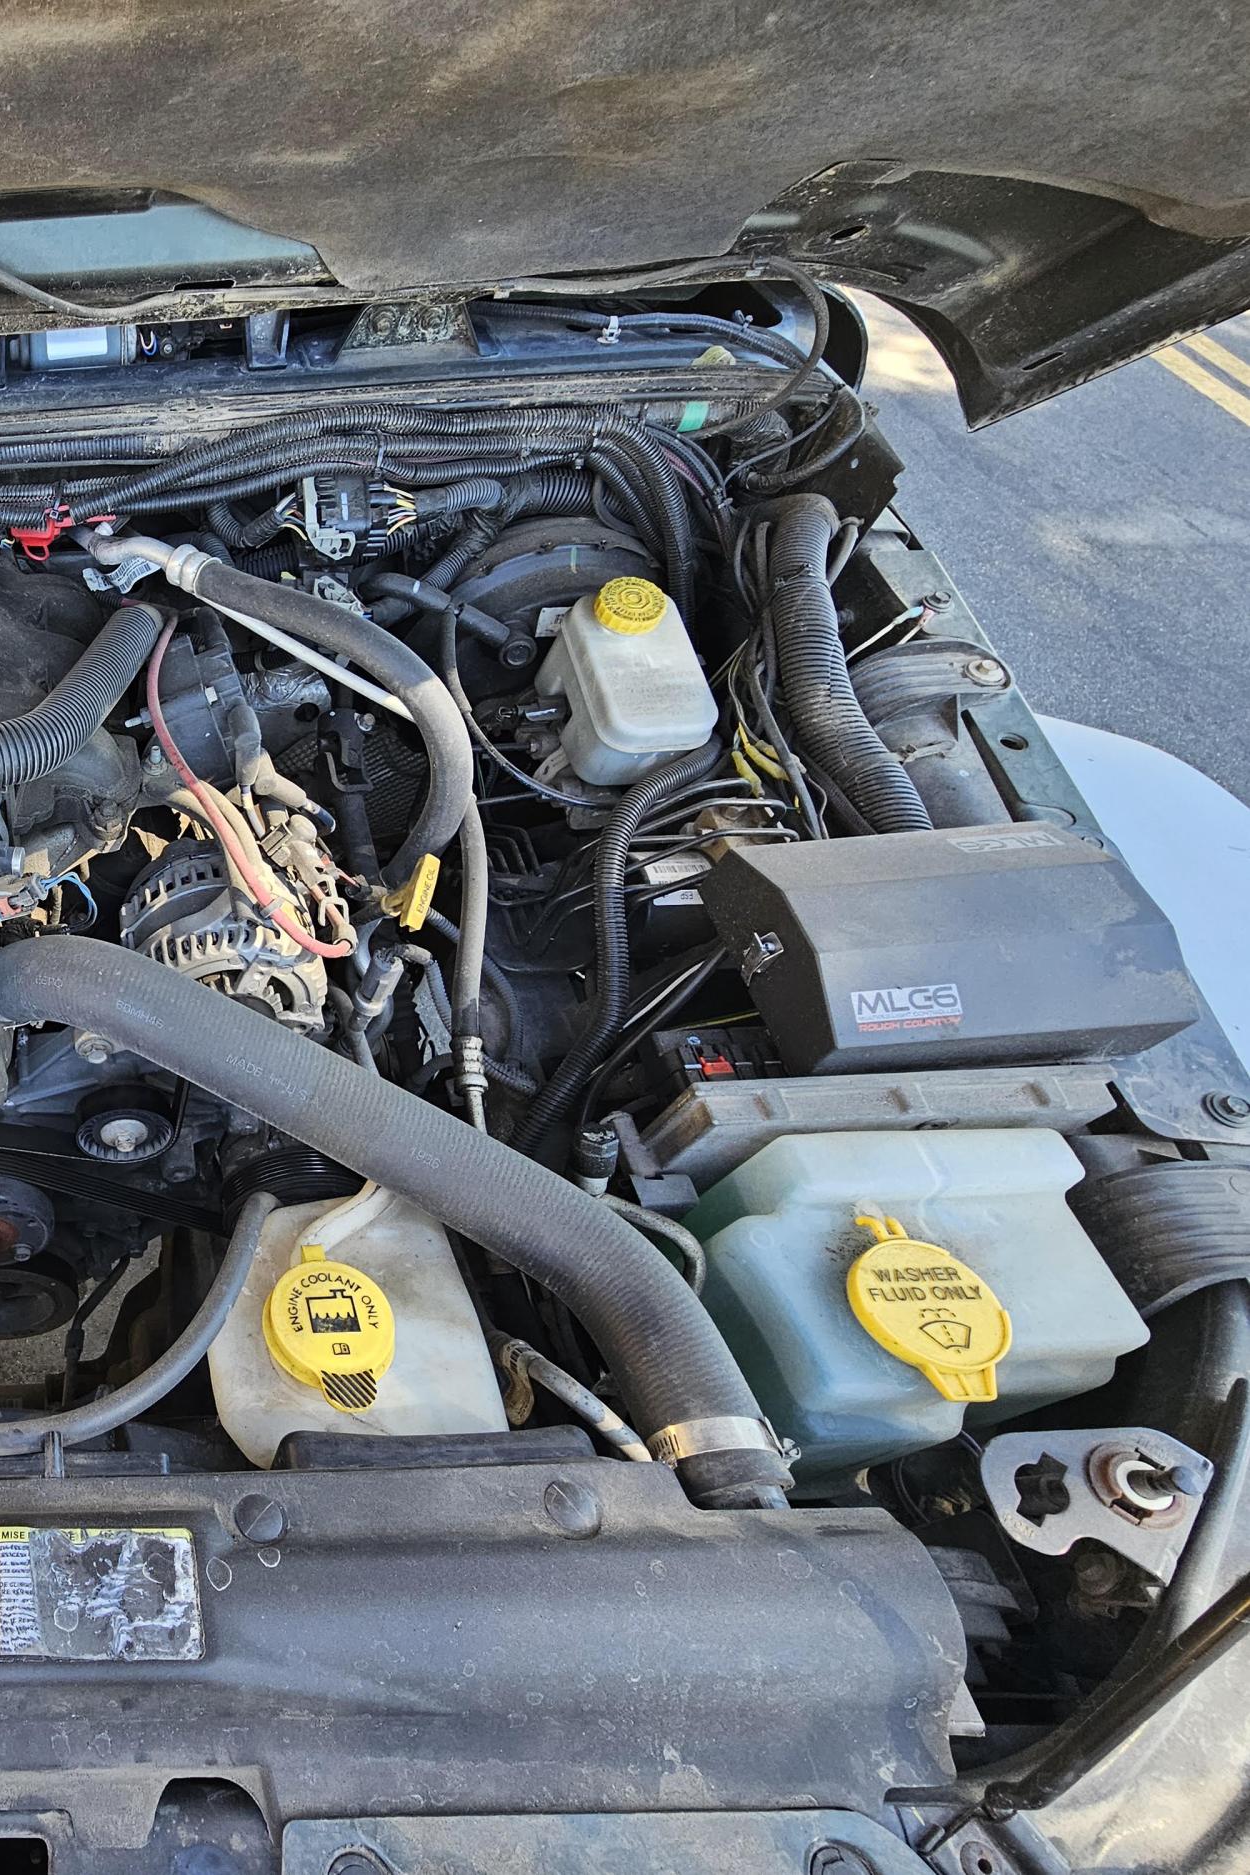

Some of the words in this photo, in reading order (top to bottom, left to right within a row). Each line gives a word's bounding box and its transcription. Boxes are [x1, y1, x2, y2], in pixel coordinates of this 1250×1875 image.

[416, 881, 432, 914] ENGINE
[426, 868, 436, 881] OIL
[859, 1021, 900, 1033] ROUGH
[902, 1016, 962, 1030] COUNTRY
[225, 1054, 264, 1077] MADE
[870, 1266, 962, 1283] WASHER
[866, 1286, 927, 1302] FLUID
[930, 1285, 983, 1301] ONLY
[287, 1286, 304, 1333] ENGINE
[300, 1272, 362, 1293] COOLANT
[361, 1294, 380, 1330] ONLY
[1, 1531, 25, 1540] MISE
